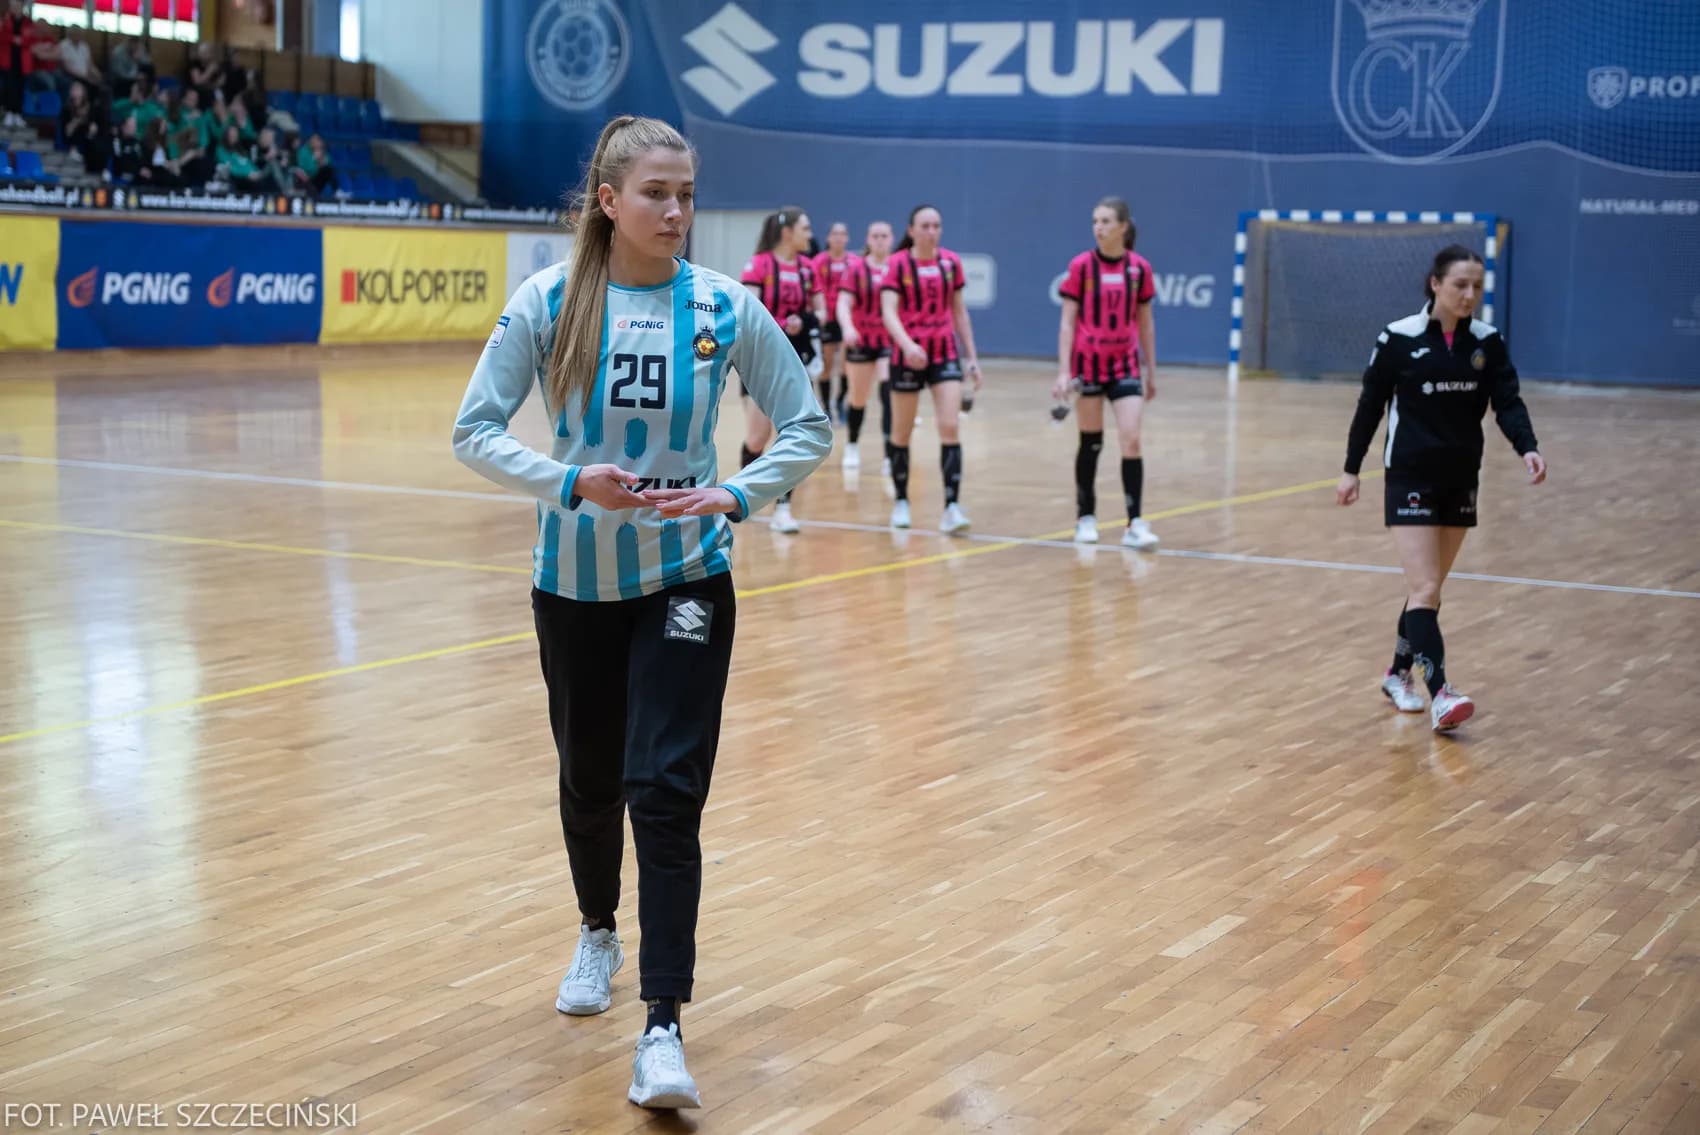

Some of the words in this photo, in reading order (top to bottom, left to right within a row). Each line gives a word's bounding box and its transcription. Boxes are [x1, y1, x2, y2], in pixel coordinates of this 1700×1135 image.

[797, 18, 1224, 97] SUZUKI
[102, 272, 191, 305] PGNiG
[236, 273, 316, 305] PGNiG
[356, 269, 487, 304] KOLPORTER
[630, 320, 664, 329] PGNiG
[610, 353, 667, 409] 29
[670, 630, 704, 641] SUZUKI
